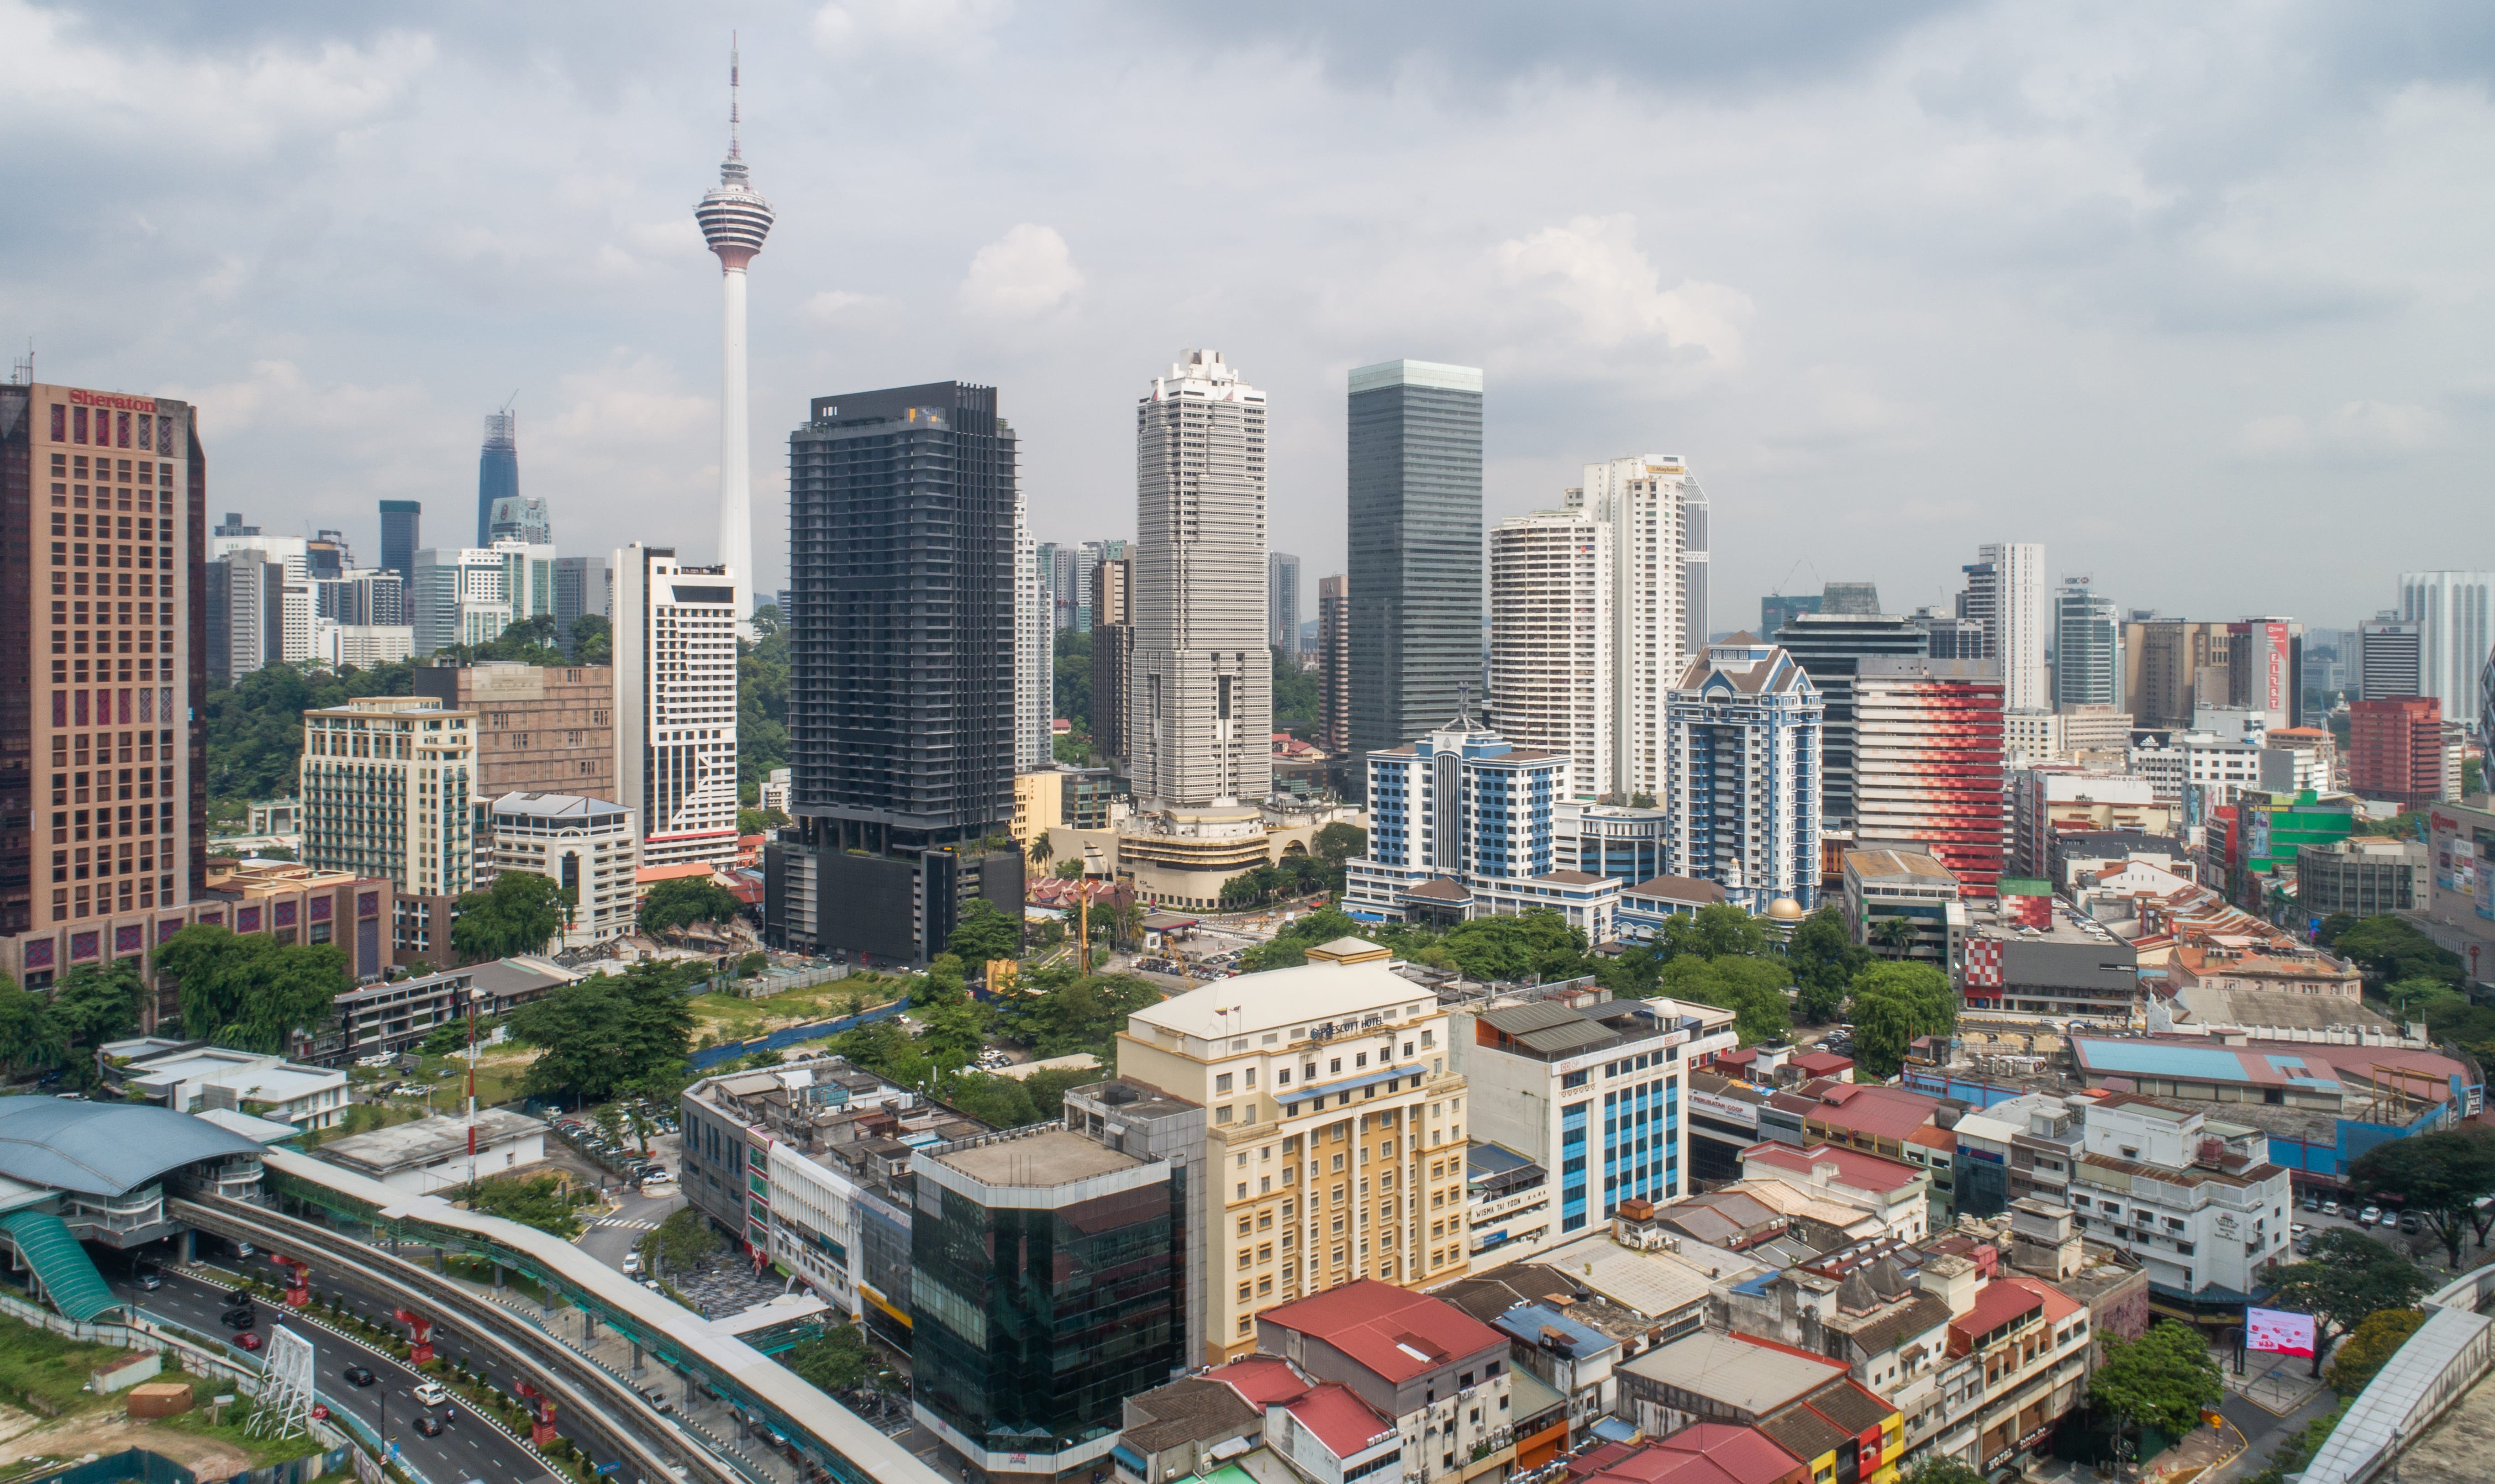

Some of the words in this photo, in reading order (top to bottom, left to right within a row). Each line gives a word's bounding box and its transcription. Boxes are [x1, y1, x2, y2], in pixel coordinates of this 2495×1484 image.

[69, 389, 156, 412] Sheraton
[1321, 1021, 1359, 1037] PRESCOTT
[1362, 1016, 1384, 1028] HOTEL
[1694, 1096, 1725, 1108] PERUBATAN
[1476, 1206, 1495, 1218] WISMA
[1496, 1202, 1505, 1211] TAI
[1507, 1197, 1521, 1207] YOON
[1988, 1447, 2014, 1471] HOTEL
